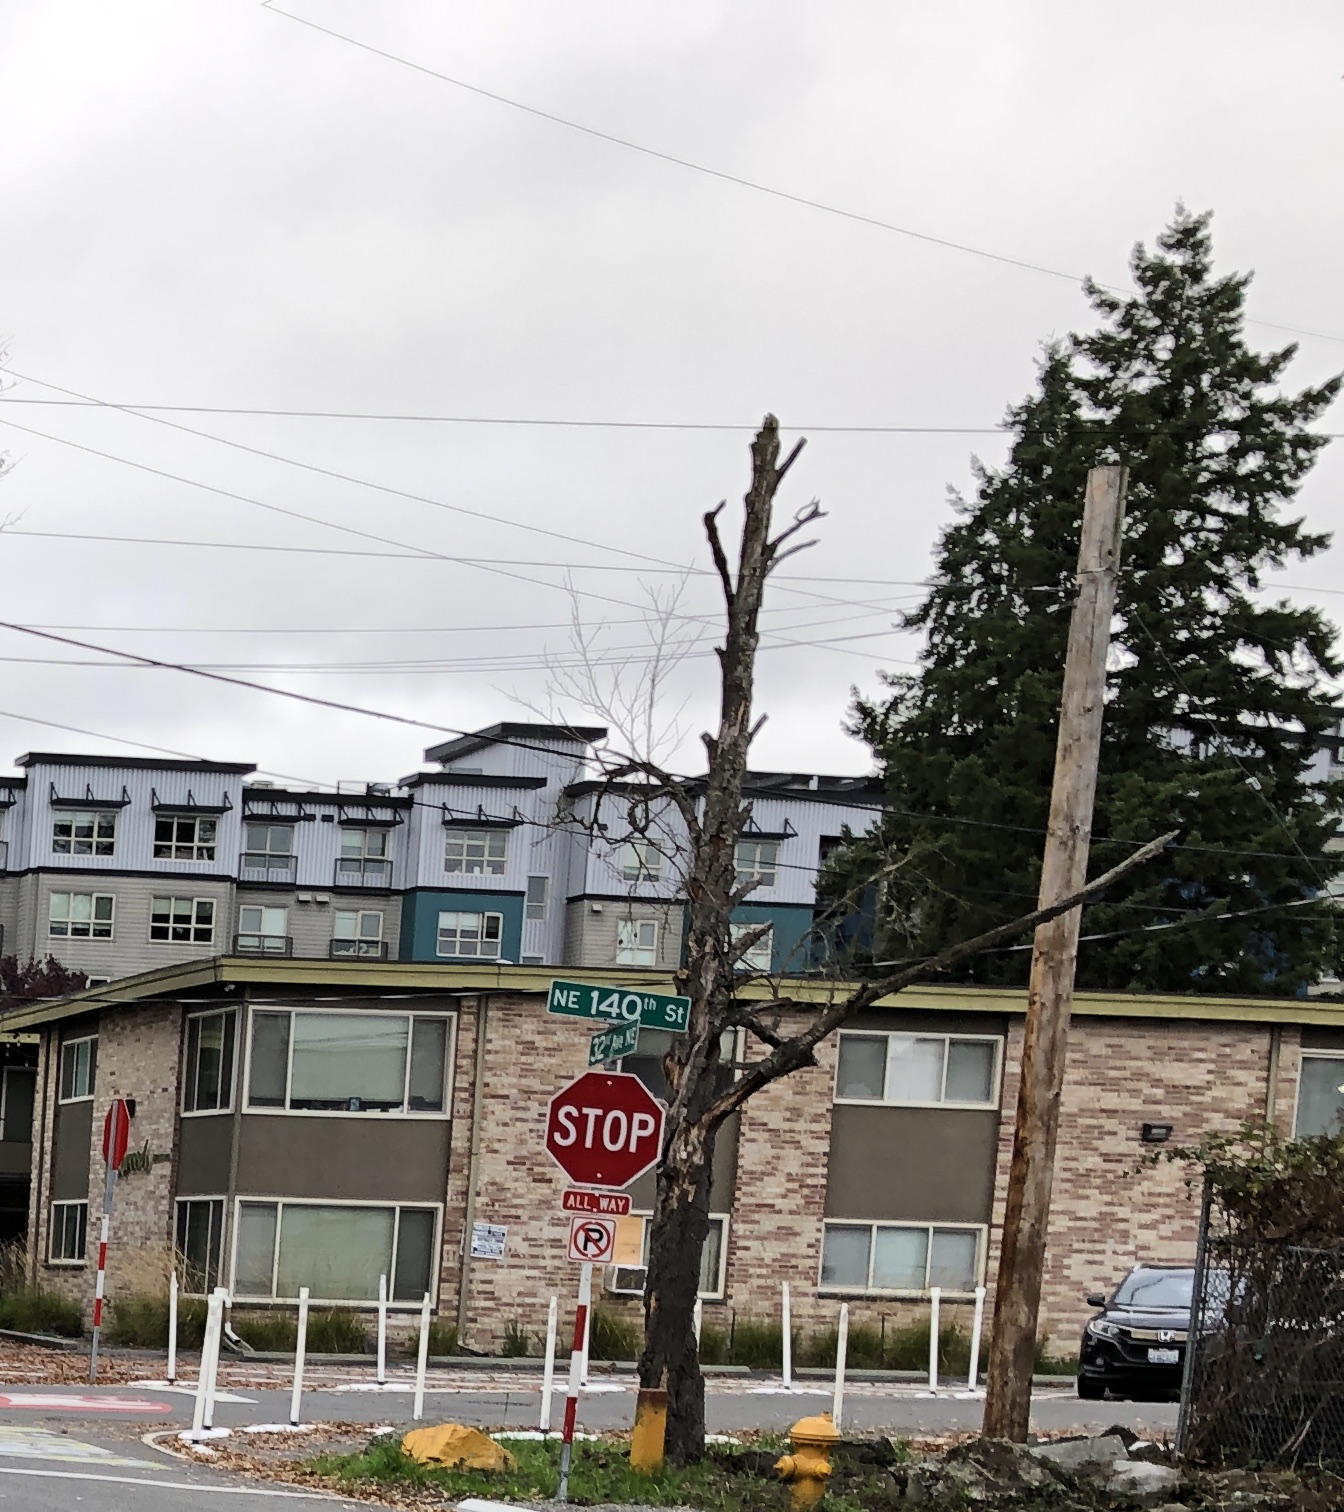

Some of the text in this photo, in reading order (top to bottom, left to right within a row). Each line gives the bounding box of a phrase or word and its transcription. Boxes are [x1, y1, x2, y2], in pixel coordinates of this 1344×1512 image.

[553, 988, 685, 1024] NE 140th St
[553, 1104, 656, 1154] STOP
[566, 1194, 626, 1213] ALL WAY
